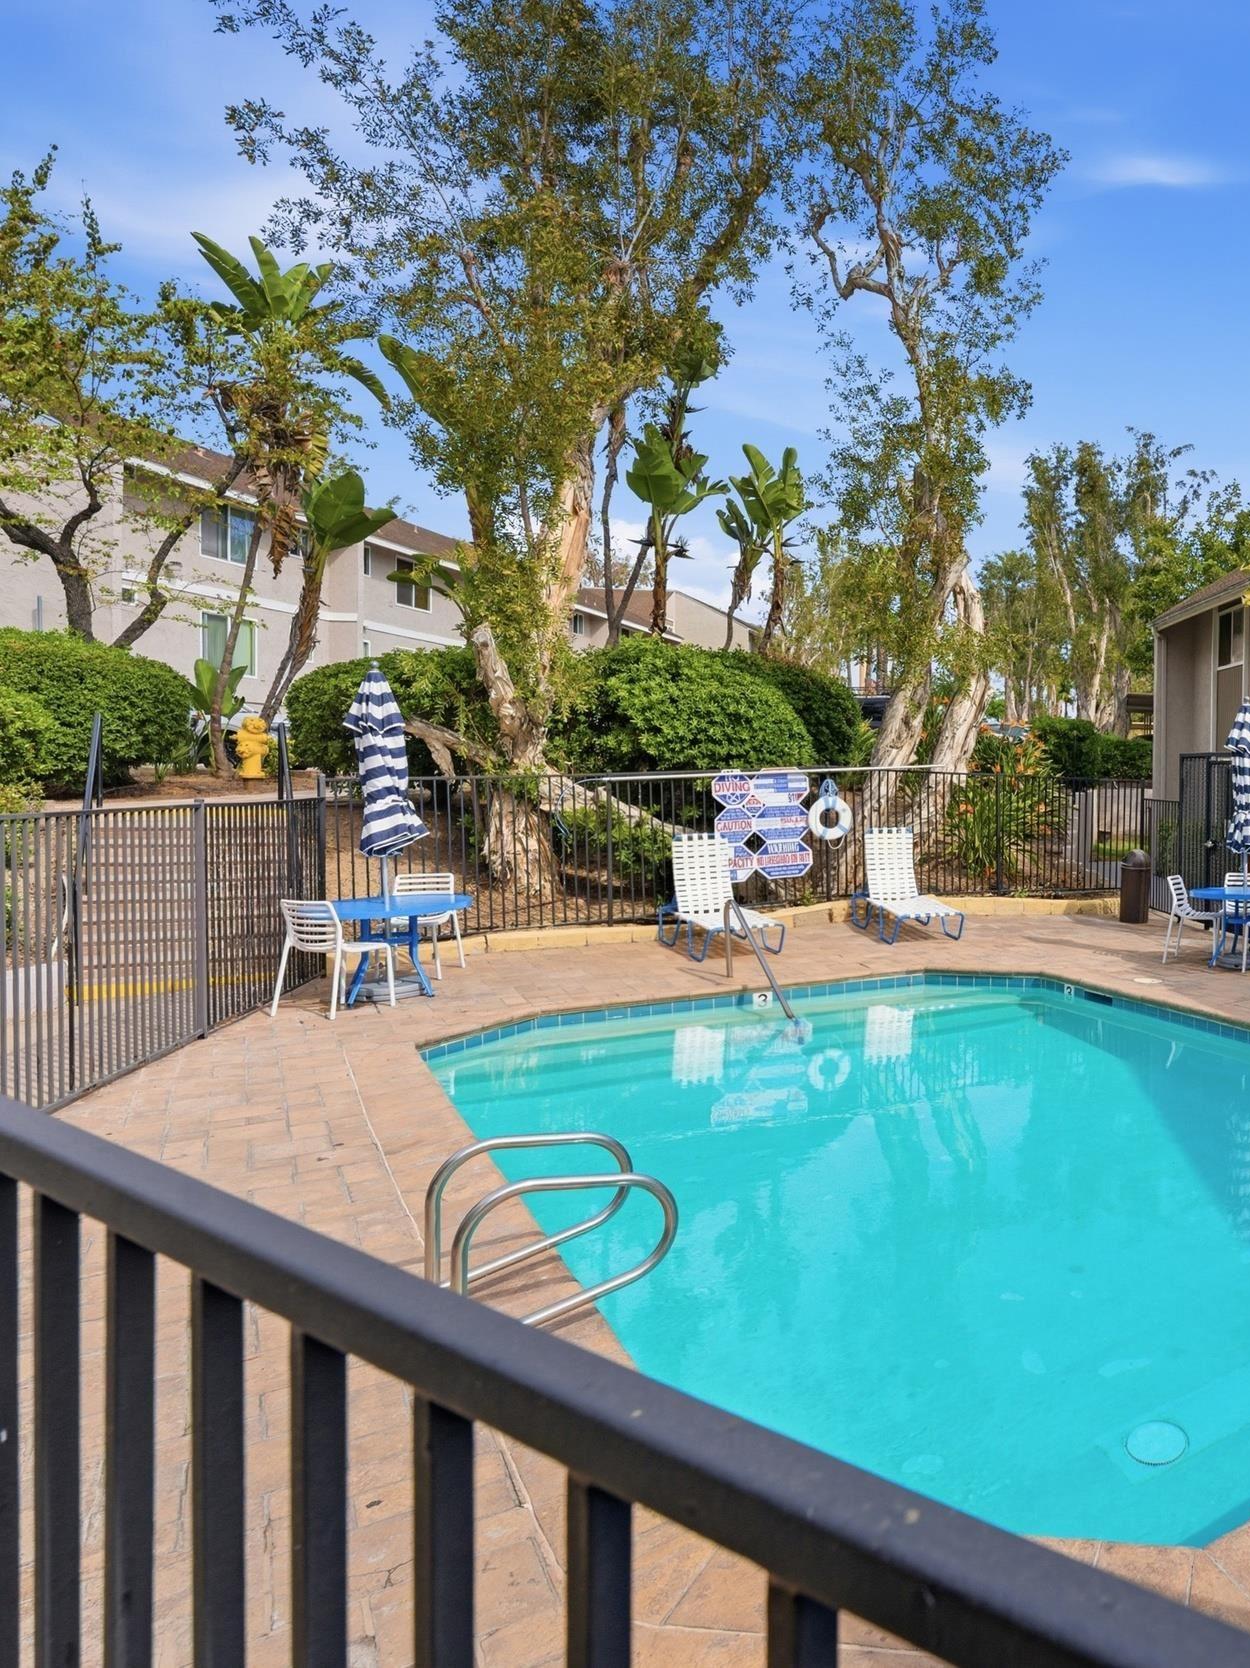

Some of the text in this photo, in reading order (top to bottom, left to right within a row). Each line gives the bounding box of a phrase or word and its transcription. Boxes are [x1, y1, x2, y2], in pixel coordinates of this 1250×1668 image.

[714, 781, 750, 793] DIVING
[716, 820, 752, 832] CAUTION
[758, 993, 768, 1008] 3
